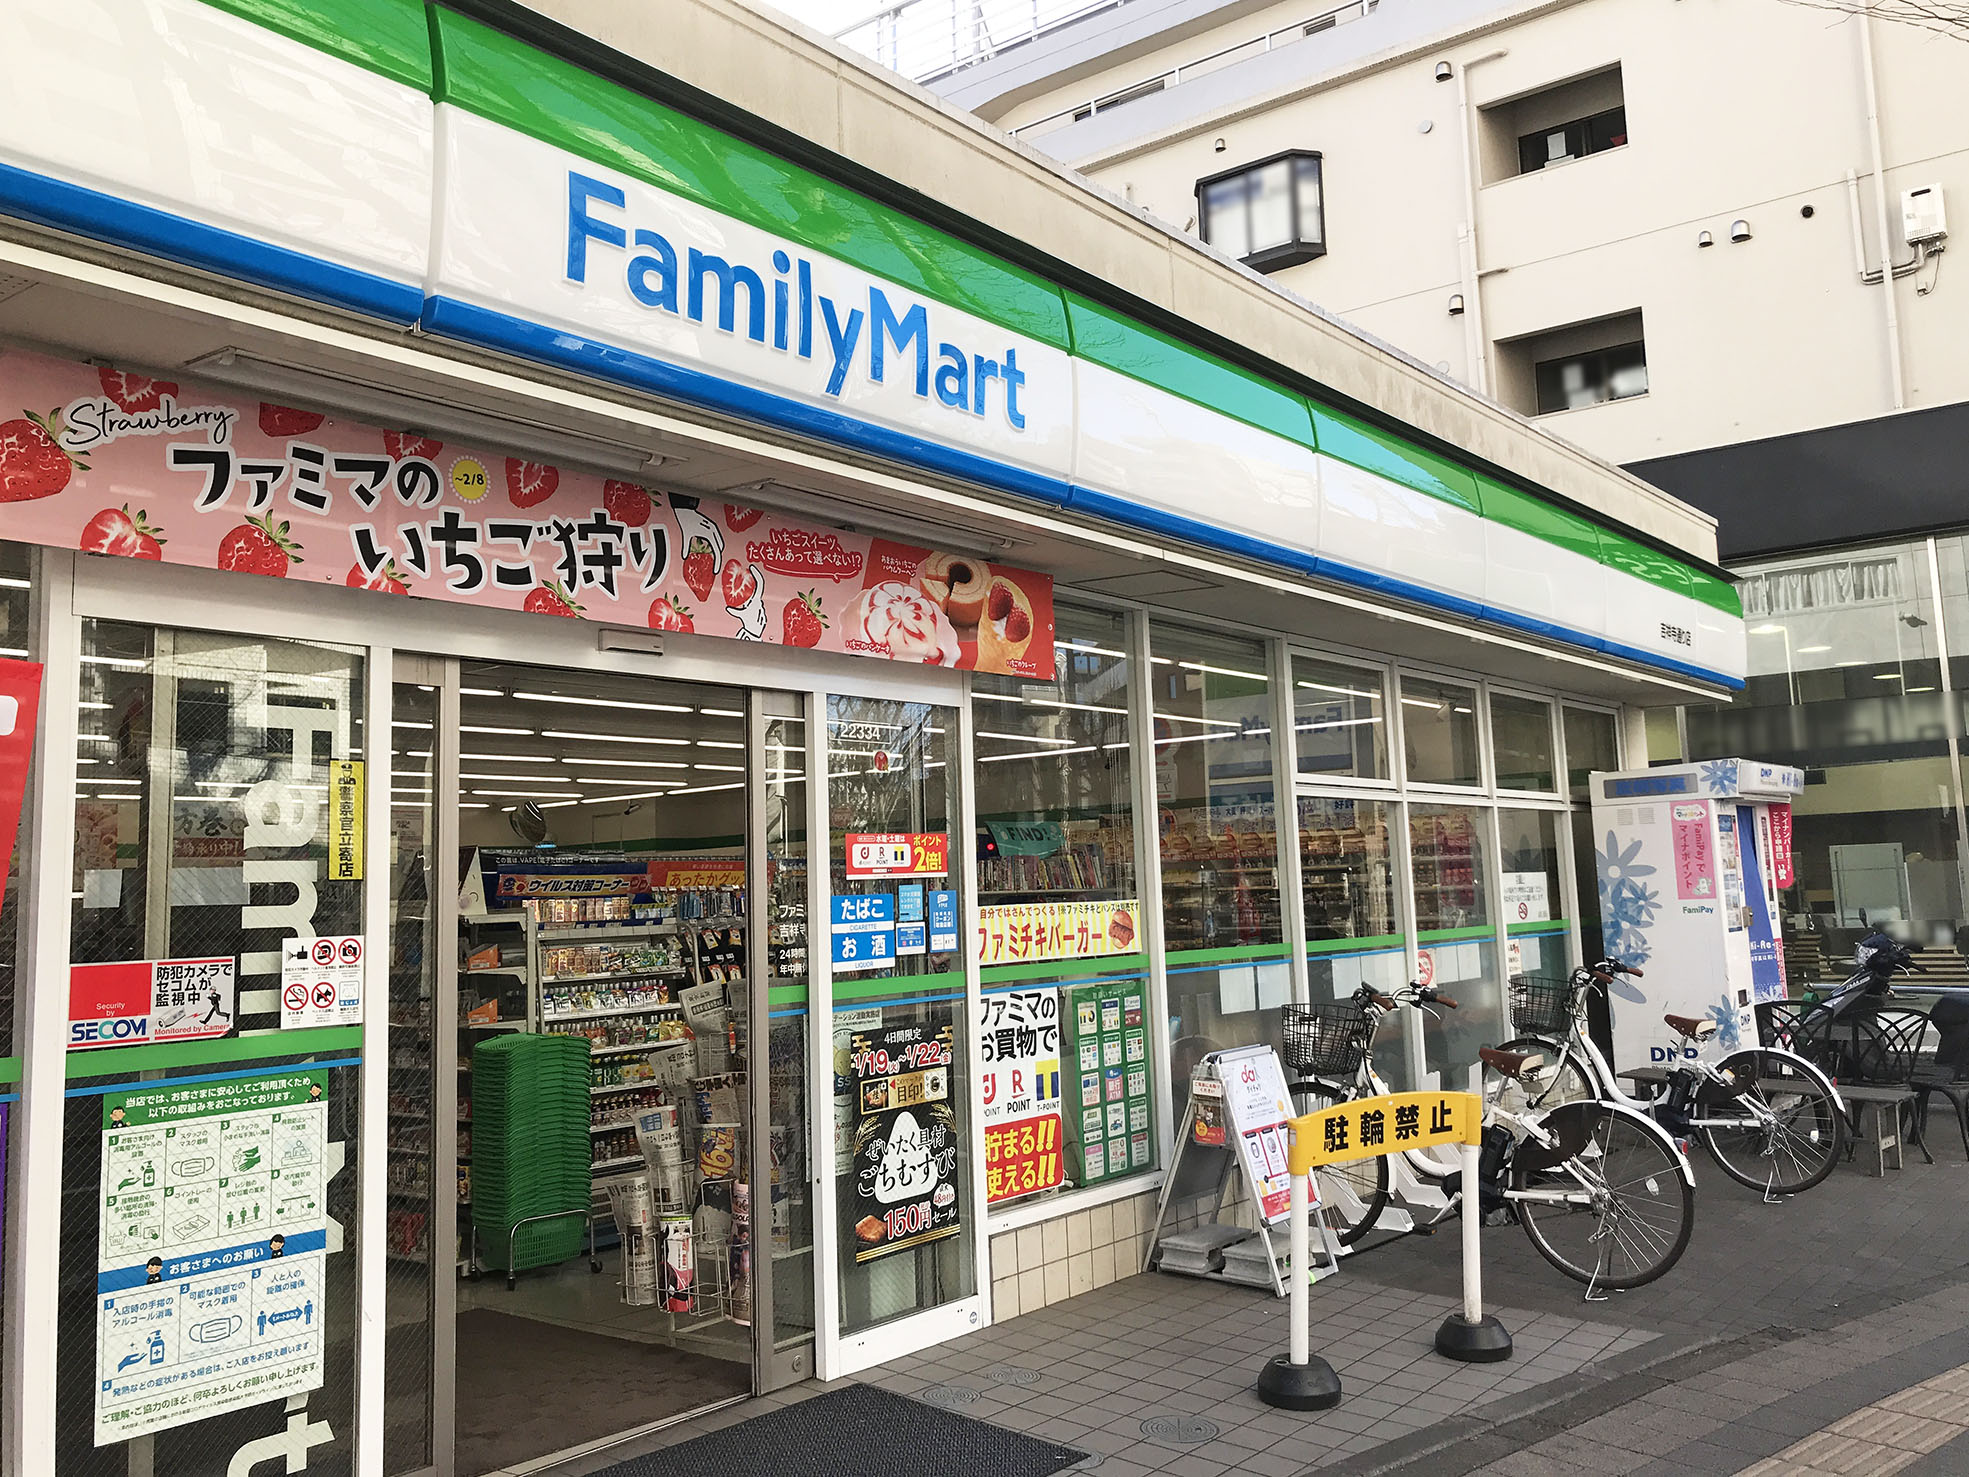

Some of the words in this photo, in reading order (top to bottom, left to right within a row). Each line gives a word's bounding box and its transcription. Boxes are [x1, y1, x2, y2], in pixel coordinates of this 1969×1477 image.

[566, 170, 1026, 430] FamilyMart
[65, 400, 234, 444] Strawberry
[170, 446, 441, 508] ファミマの
[772, 531, 841, 552] いちごスイーツ、
[354, 511, 666, 597] いちご狩り
[840, 722, 881, 741] 22334
[913, 835, 942, 847] ポイント
[1007, 827, 1050, 841] FIND!
[914, 846, 942, 872] 2倍!
[528, 879, 630, 892] ウイルス対策コーナー
[841, 899, 884, 921] たばこ
[1683, 906, 1714, 914] FamiPay
[849, 923, 877, 931] CIGARETTE
[841, 935, 886, 959] お酒
[978, 920, 1102, 960] ファミチキバーガー
[157, 963, 233, 981] 防犯カメラで
[854, 960, 873, 969] LIQUOR
[157, 978, 212, 993] セコムが
[96, 1002, 126, 1011] Security
[155, 991, 201, 1008] 監視中
[981, 992, 1056, 1027] ファミマの
[106, 1010, 116, 1018] by
[72, 1018, 147, 1042] SECOM
[154, 1025, 192, 1036] Monitored
[192, 1025, 202, 1034] by
[884, 1027, 922, 1044] 4日間限定
[125, 1076, 310, 1107] 当店では、お客さまに安心してご利用頂くため
[1012, 1069, 1025, 1094] R
[897, 1083, 923, 1103] 目印!
[148, 1089, 294, 1118] 以下の取組みをおこなっております。
[984, 1106, 1000, 1117] OINT
[1007, 1099, 1031, 1114] POINT
[1037, 1101, 1060, 1112] T-POINT
[180, 1129, 207, 1139] スタッフの
[1323, 1100, 1453, 1153] 駐輪禁止
[866, 1124, 946, 1161] ぜいたく具材
[985, 1119, 1056, 1163] 貯まる!!
[857, 1147, 956, 1198] ごちむすび
[986, 1153, 1057, 1199] 使える!!
[884, 1203, 931, 1240] 150円
[932, 1207, 957, 1223] セール
[169, 1246, 263, 1275] お客さまへのお願い
[271, 1269, 300, 1282] 人と人の
[189, 1281, 245, 1300] 可能な範囲での
[266, 1279, 304, 1295] 距離の確保
[112, 1296, 173, 1317] 入店時の手指の
[197, 1294, 237, 1310] マスク着用
[112, 1307, 172, 1329] アルコール消毒
